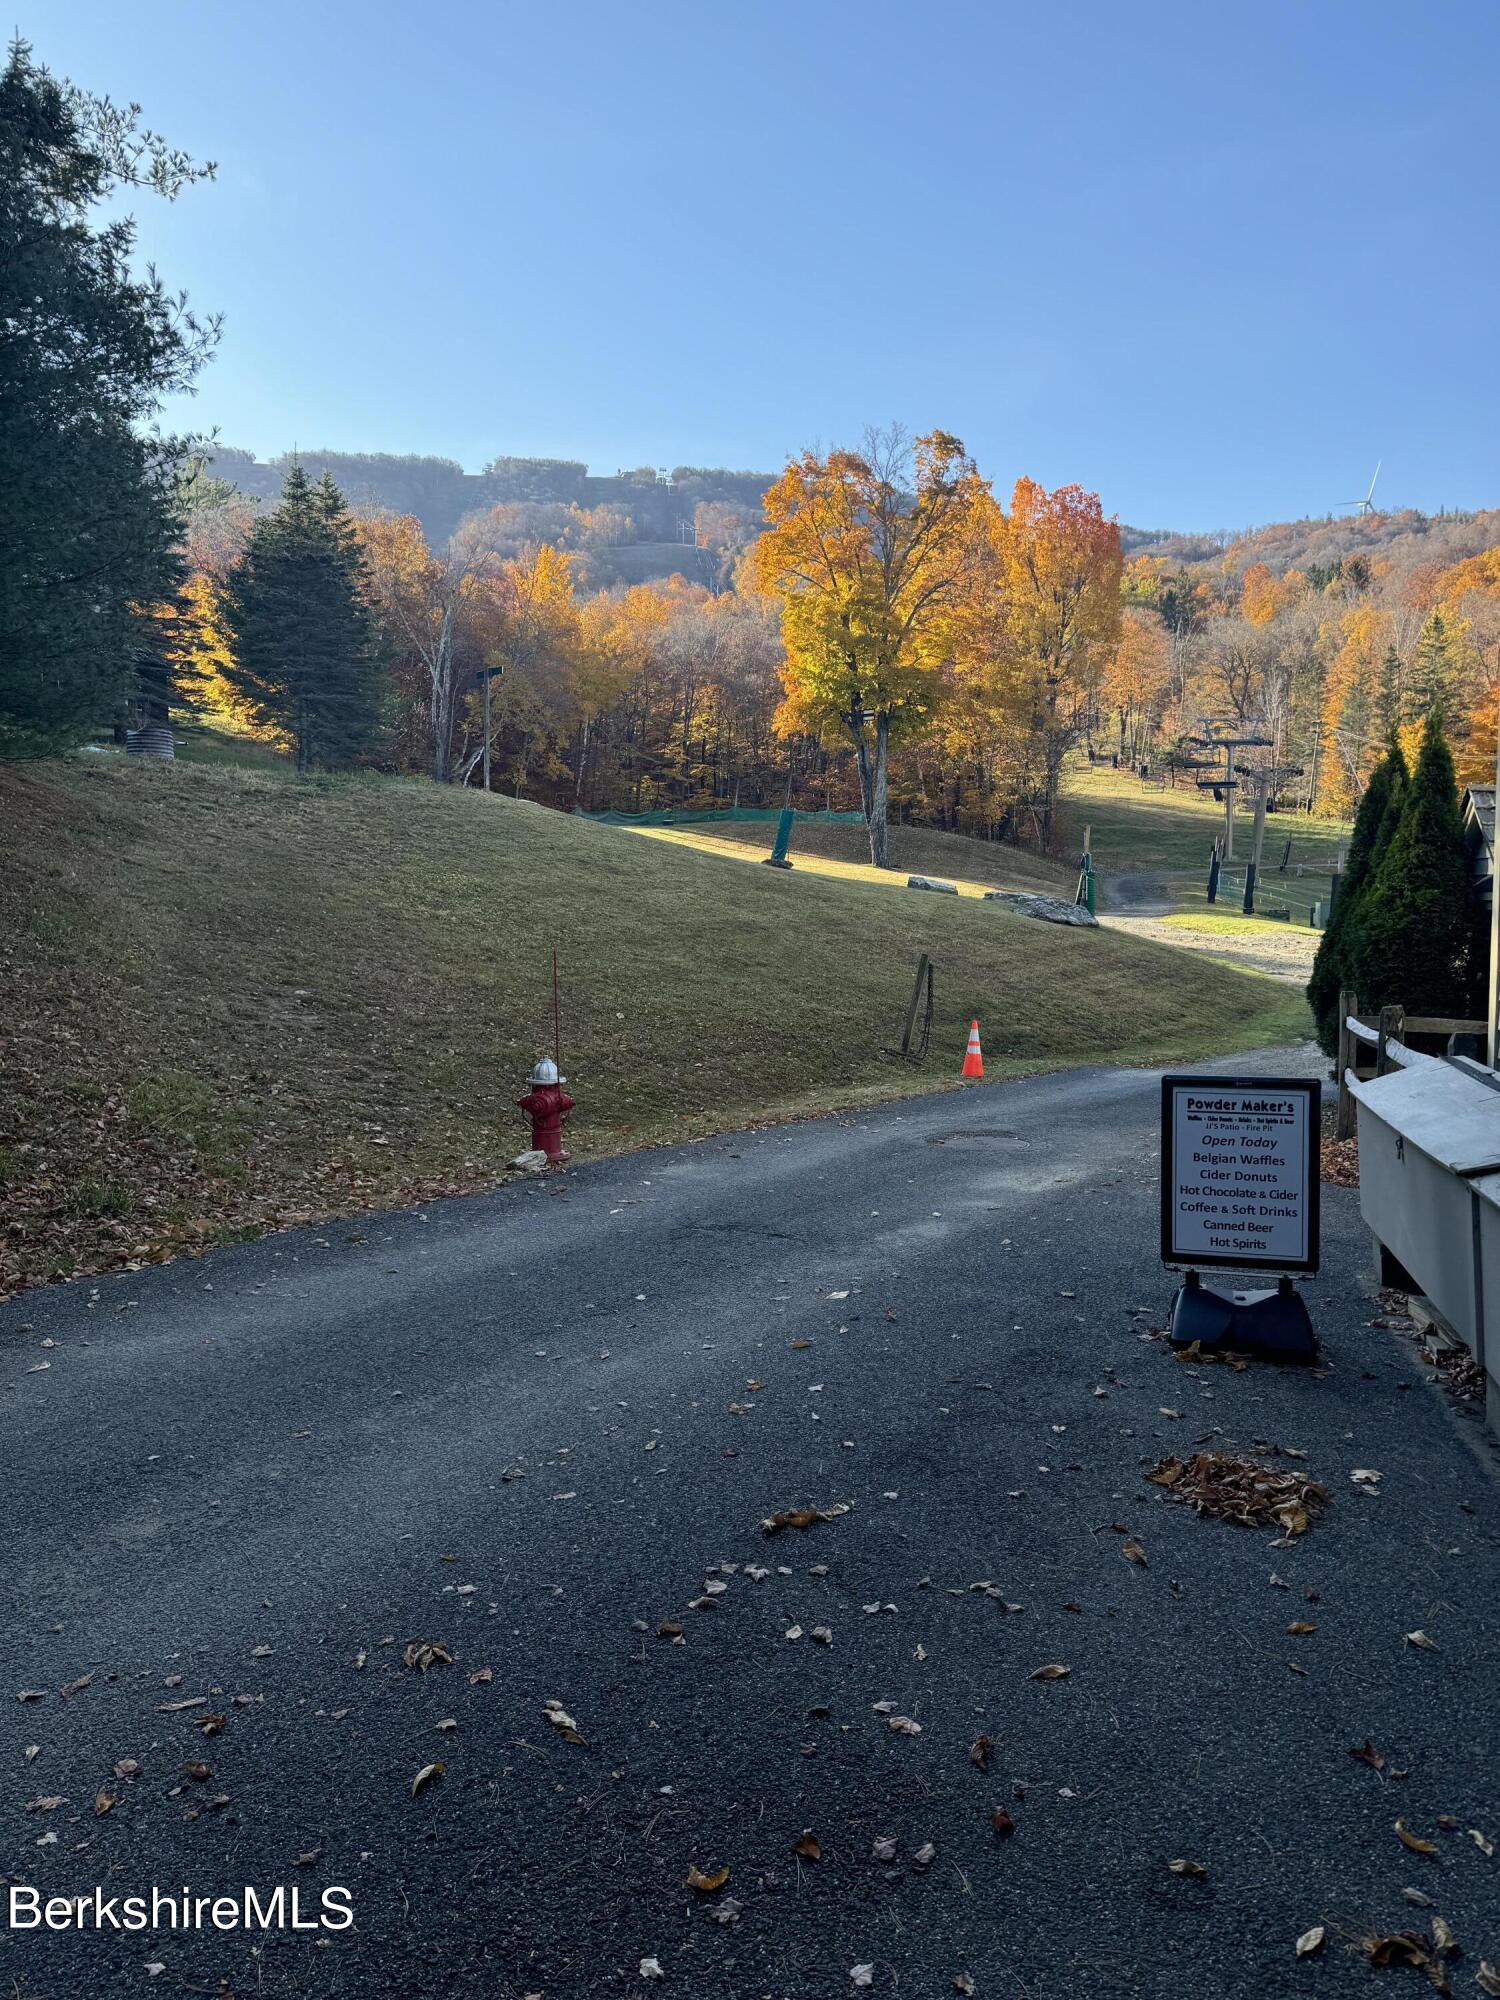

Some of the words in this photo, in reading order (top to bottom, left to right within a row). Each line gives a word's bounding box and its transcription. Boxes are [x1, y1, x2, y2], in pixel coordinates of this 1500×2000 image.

[1187, 1098, 1237, 1110] Powder
[1242, 1100, 1294, 1112] Maker's
[1202, 1135, 1236, 1148] Open
[1240, 1136, 1278, 1150] Today
[1193, 1152, 1236, 1165] Belgian
[1240, 1154, 1286, 1166] Waffles
[1200, 1170, 1231, 1180] Cider
[1234, 1171, 1278, 1182] Donuts
[1180, 1184, 1200, 1196] Hot
[1202, 1186, 1256, 1198] Chocolate
[1270, 1189, 1298, 1200] Cider
[1180, 1202, 1218, 1213] Coffee
[1232, 1204, 1256, 1215] Soft
[1260, 1206, 1298, 1218] Drinks
[1203, 1220, 1245, 1232] Canned
[1248, 1222, 1274, 1232] Beer
[1210, 1236, 1230, 1248] Hot
[1233, 1238, 1267, 1250] Spirits
